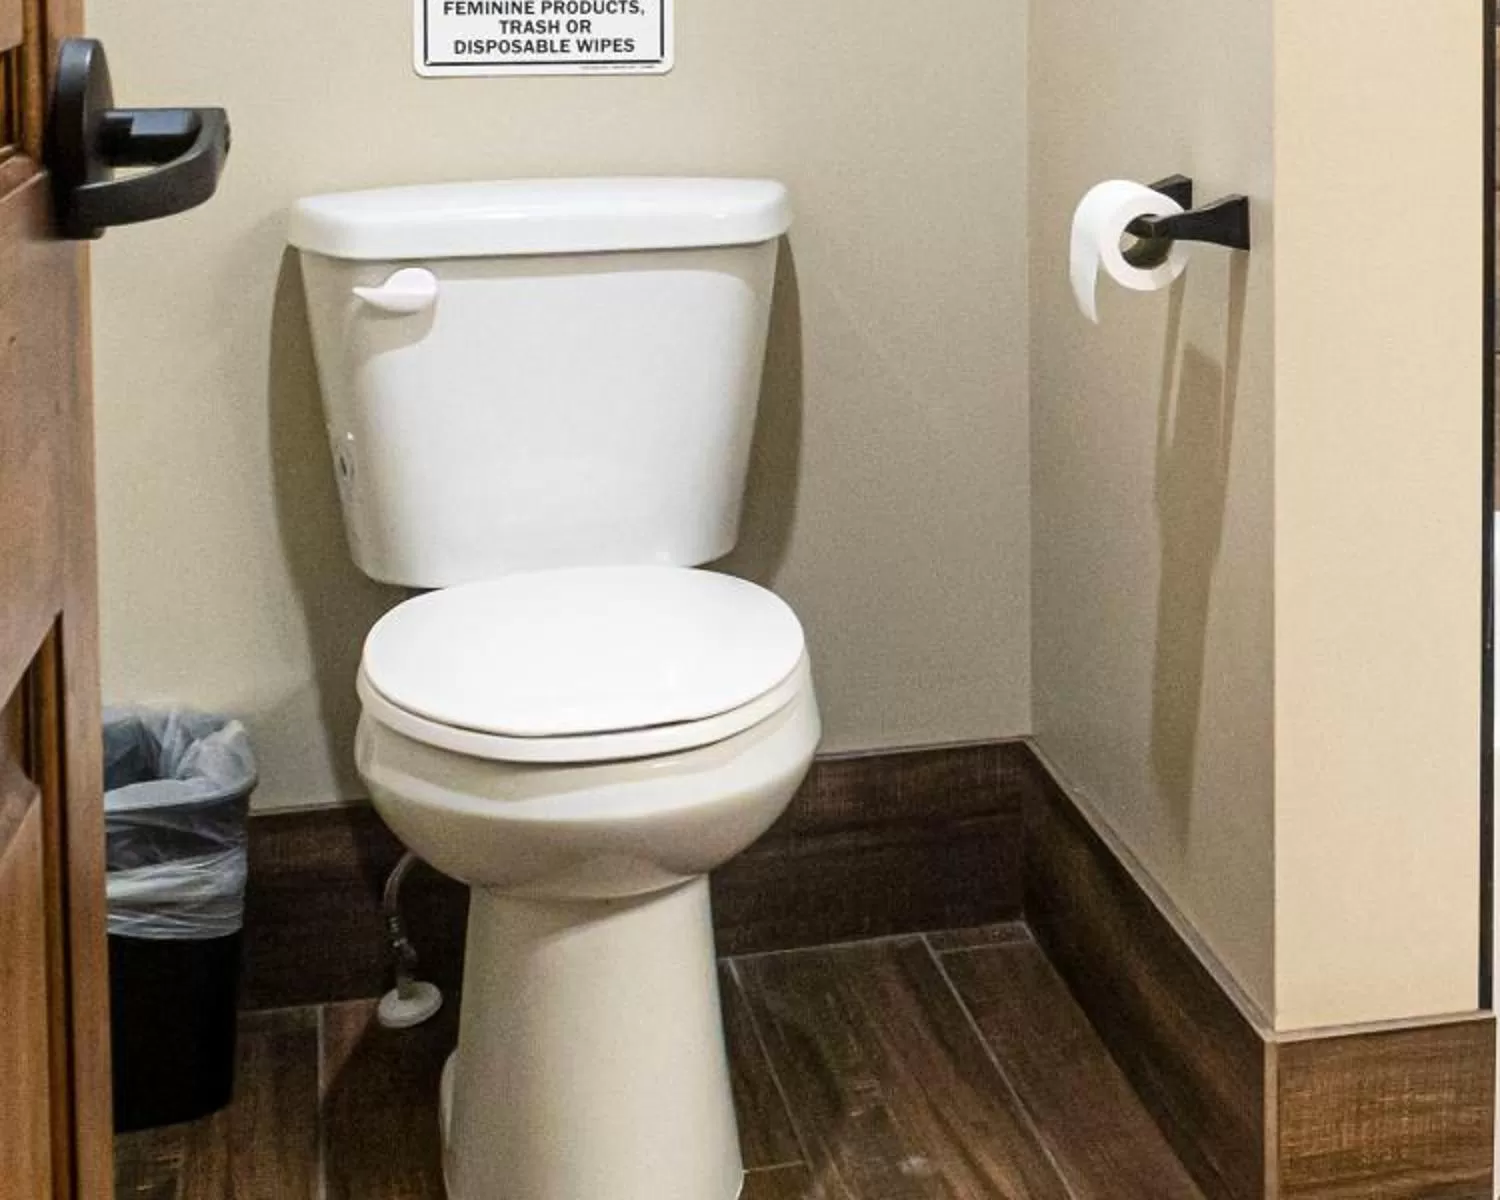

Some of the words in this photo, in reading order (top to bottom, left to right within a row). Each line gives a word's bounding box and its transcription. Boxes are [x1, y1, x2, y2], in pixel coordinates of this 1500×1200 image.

[443, 0, 535, 16] FEMININE
[541, 0, 646, 16] PRODUCTS,
[499, 19, 560, 34] TRASH
[566, 19, 592, 33] OR
[453, 38, 571, 55] DISPOSABLE
[576, 38, 635, 53] WIPES
